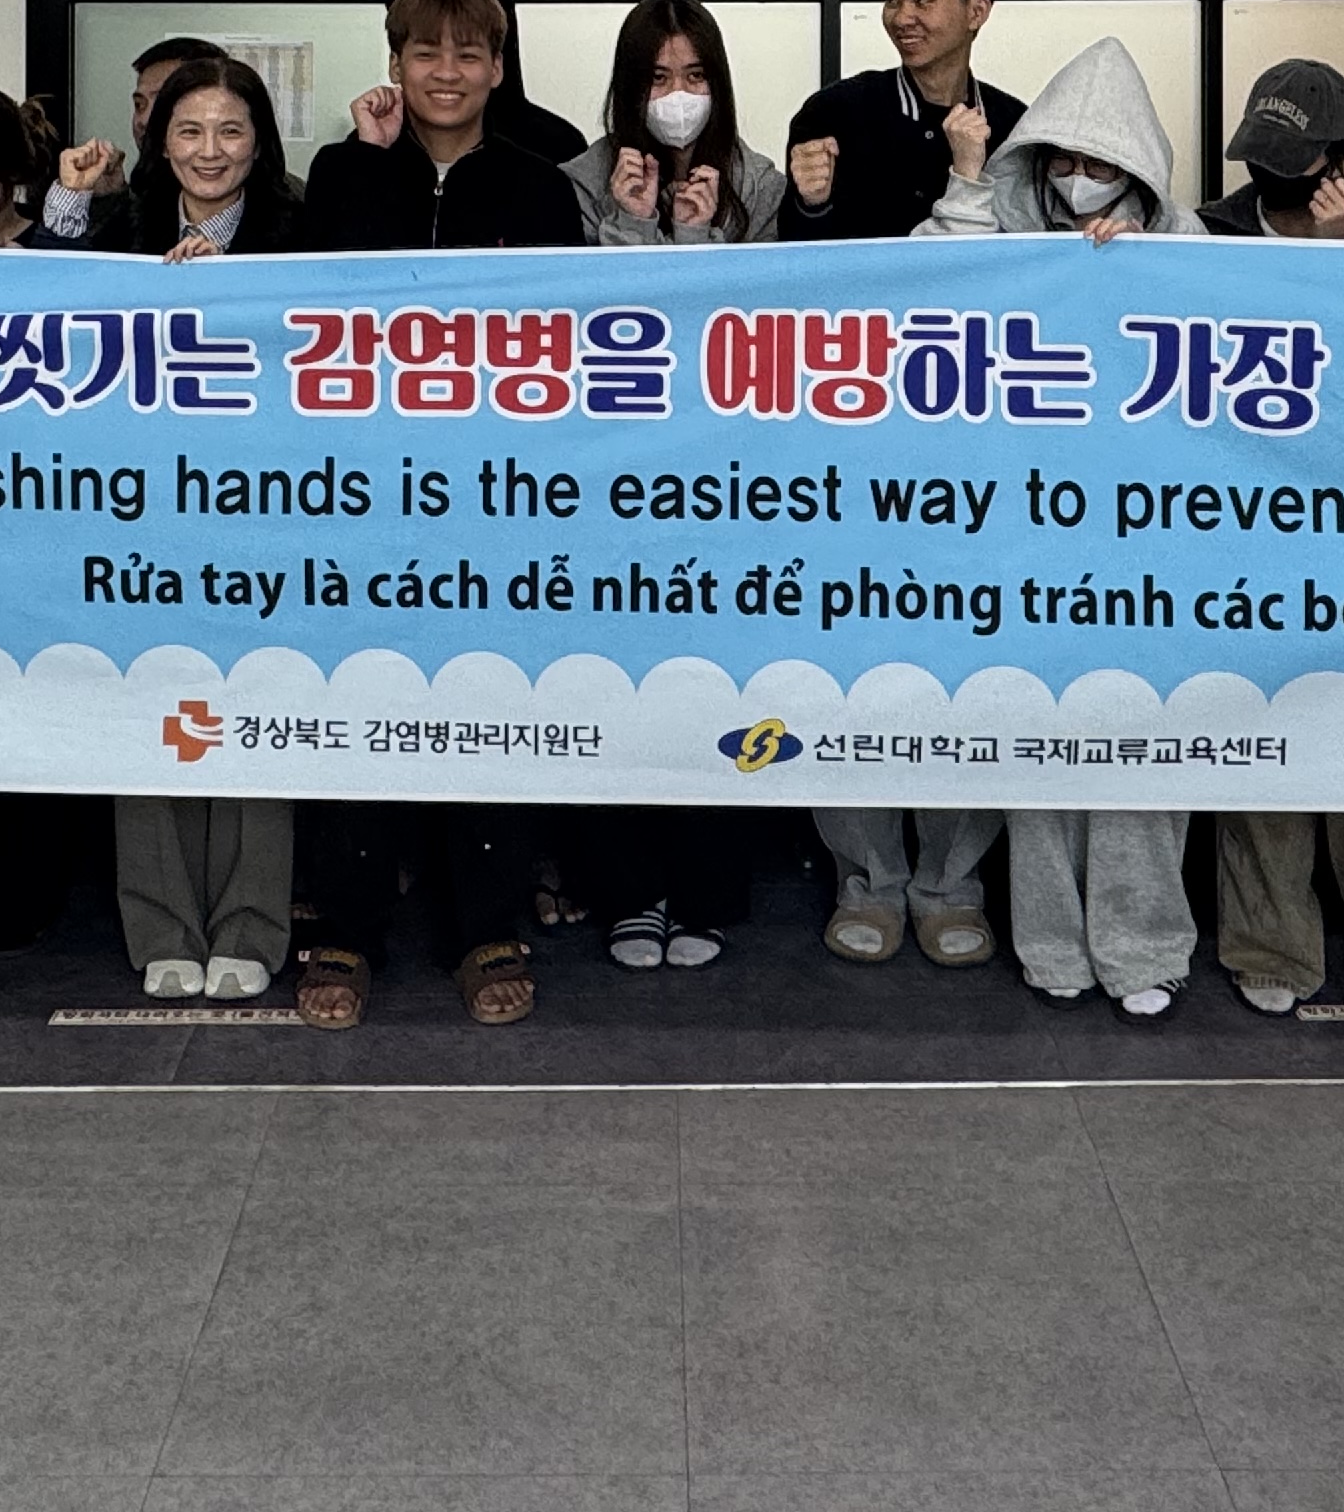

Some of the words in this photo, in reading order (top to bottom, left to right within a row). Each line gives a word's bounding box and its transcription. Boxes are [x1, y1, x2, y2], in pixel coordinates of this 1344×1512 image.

[288, 311, 672, 414] 감염병을
[702, 310, 1092, 421] 예방하는
[1122, 318, 1327, 429] 가장
[176, 453, 371, 517] hands
[402, 456, 450, 516] is
[479, 459, 579, 517] the
[609, 464, 841, 521] easiest
[869, 475, 995, 534] way
[1028, 470, 1087, 528] to
[84, 554, 182, 607] Rửa
[200, 562, 285, 620] tay
[303, 556, 350, 607] là
[366, 556, 489, 610] cách
[507, 550, 574, 612] dễ
[592, 553, 718, 614] nhất
[734, 555, 803, 616] để
[820, 565, 1002, 633] phòng
[1019, 574, 1174, 628] tránh
[1192, 576, 1286, 633] các
[233, 717, 351, 752] 경상북도
[363, 720, 603, 757] 감염병관리지원단
[813, 732, 1000, 764] 선린대학교
[1012, 736, 1287, 767] 국제교류교육센터
